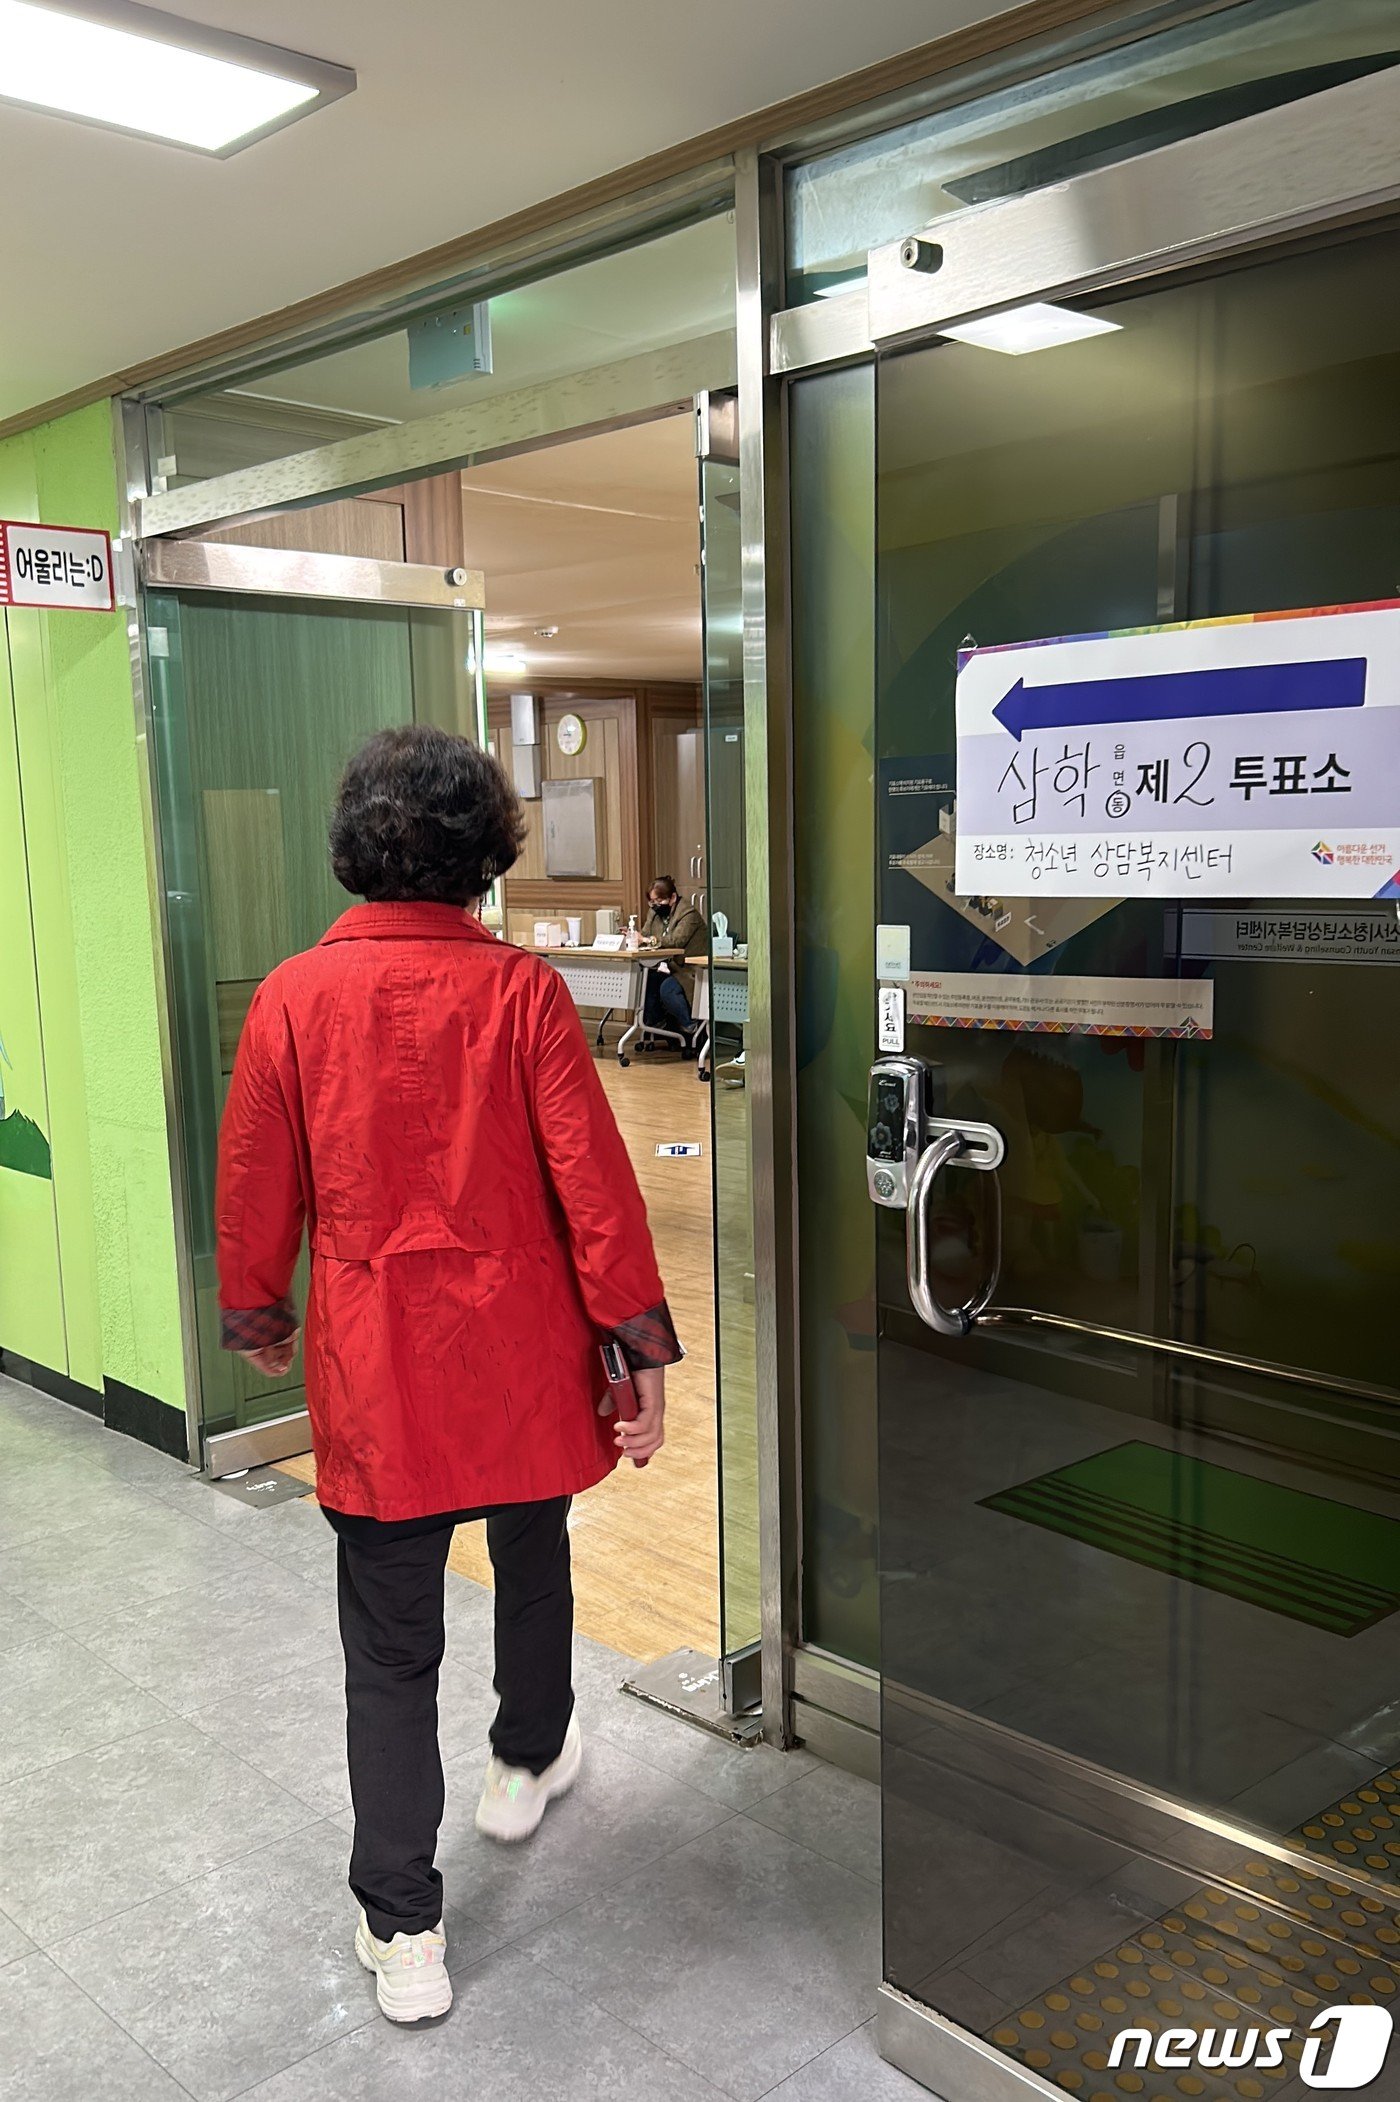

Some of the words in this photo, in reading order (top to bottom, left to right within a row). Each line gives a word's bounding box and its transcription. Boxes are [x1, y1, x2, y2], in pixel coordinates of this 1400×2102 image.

[16, 547, 104, 588] 어울리는:D
[1113, 744, 1126, 760] 읍
[997, 741, 1101, 824] 삼학
[1112, 770, 1125, 786] 면
[1228, 752, 1352, 801] 투표소
[1111, 797, 1125, 813] 동
[973, 842, 1015, 861] 장소명:
[1024, 837, 1078, 880] 청소년
[1090, 840, 1233, 882] 상담복지센터
[882, 1037, 900, 1046] PULL
